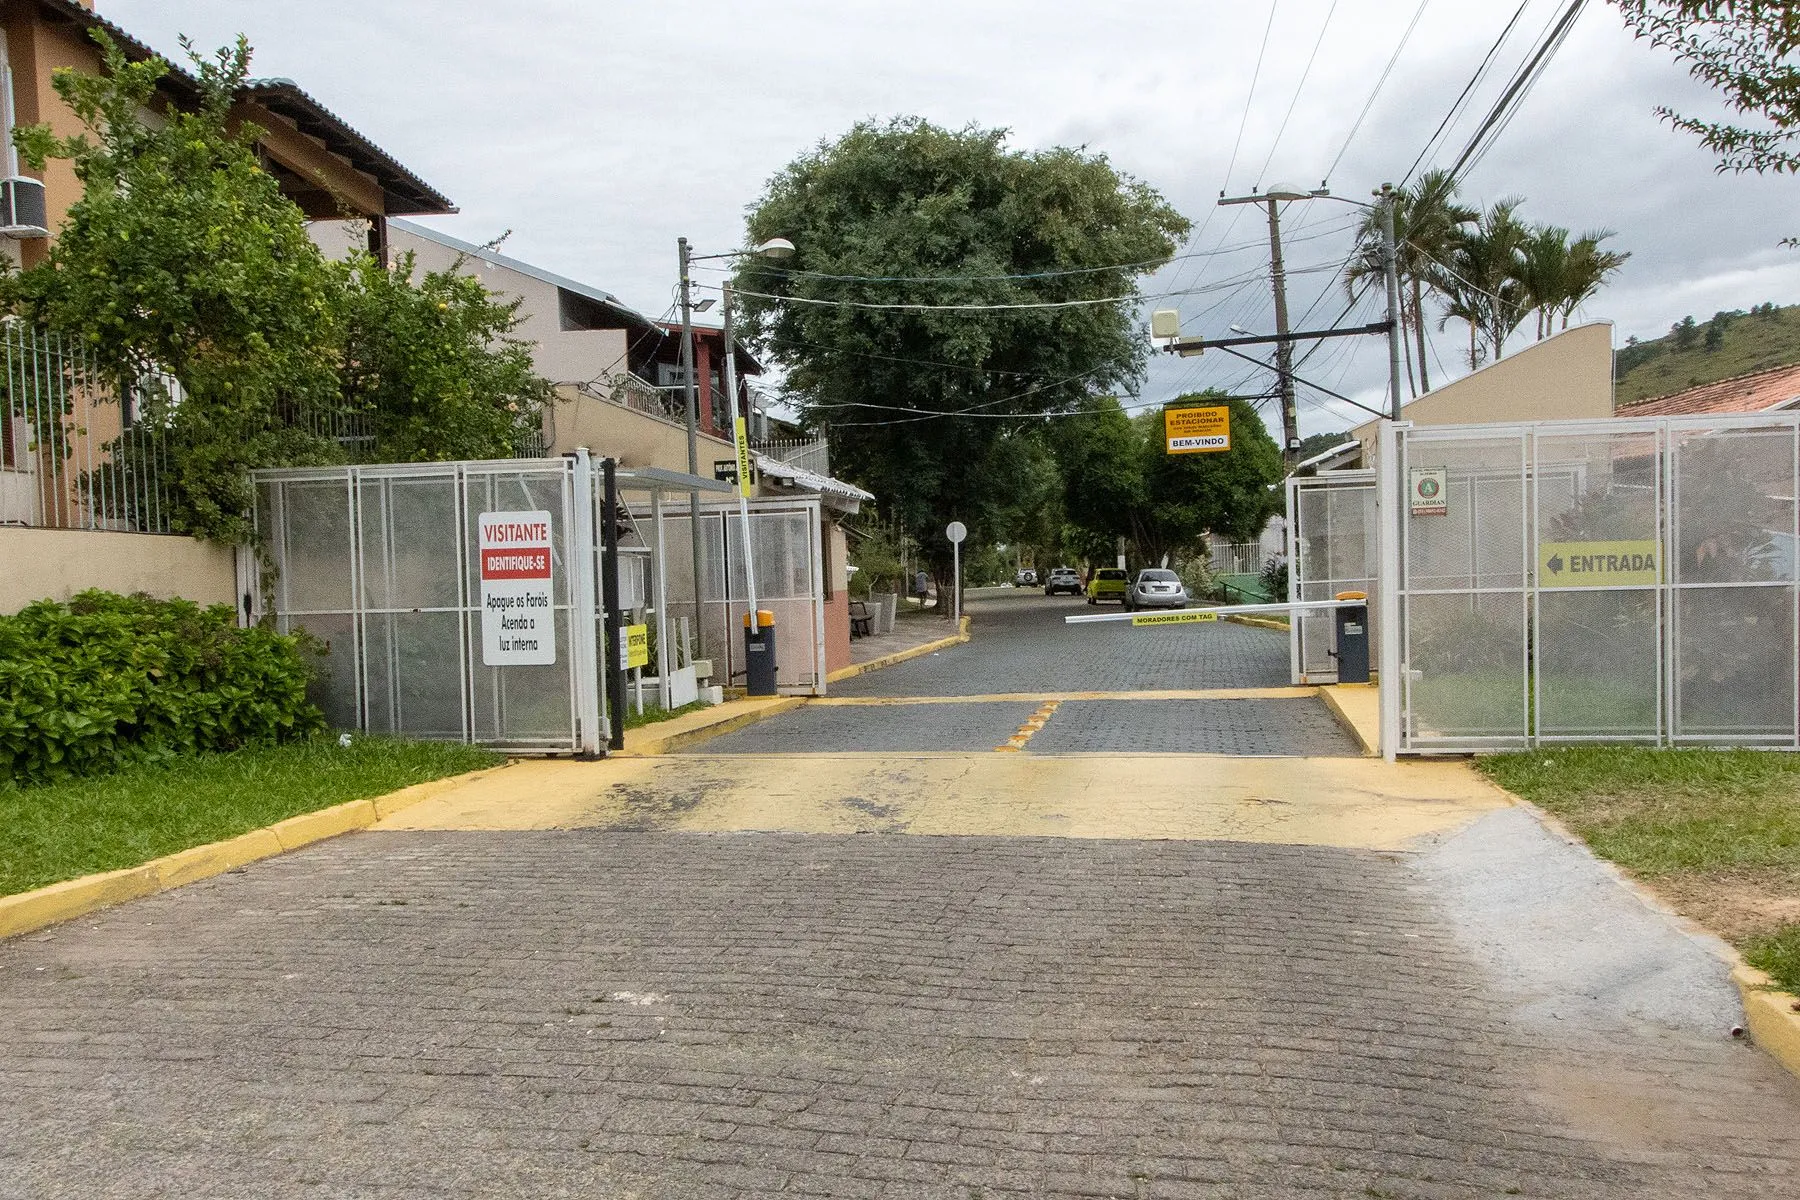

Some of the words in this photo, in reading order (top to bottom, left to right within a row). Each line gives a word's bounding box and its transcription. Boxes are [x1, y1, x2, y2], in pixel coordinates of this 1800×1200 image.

[1170, 417, 1224, 426] ESTACIONAR
[1176, 411, 1217, 419] PROIBIDO
[1172, 437, 1224, 447] BEM-VINDO
[739, 435, 748, 479] VISITANTES
[484, 523, 547, 542] VISITANTE
[487, 555, 545, 572] IDENTIFIQUE-SE
[1570, 553, 1656, 573] ENTRADA
[486, 593, 515, 612] Apague
[516, 596, 525, 608] os
[526, 592, 549, 608] Faróis
[501, 614, 528, 630] Acenda
[529, 618, 535, 630] a
[1137, 615, 1180, 623] MORADORES
[499, 635, 510, 651] luz
[511, 635, 538, 651] interna
